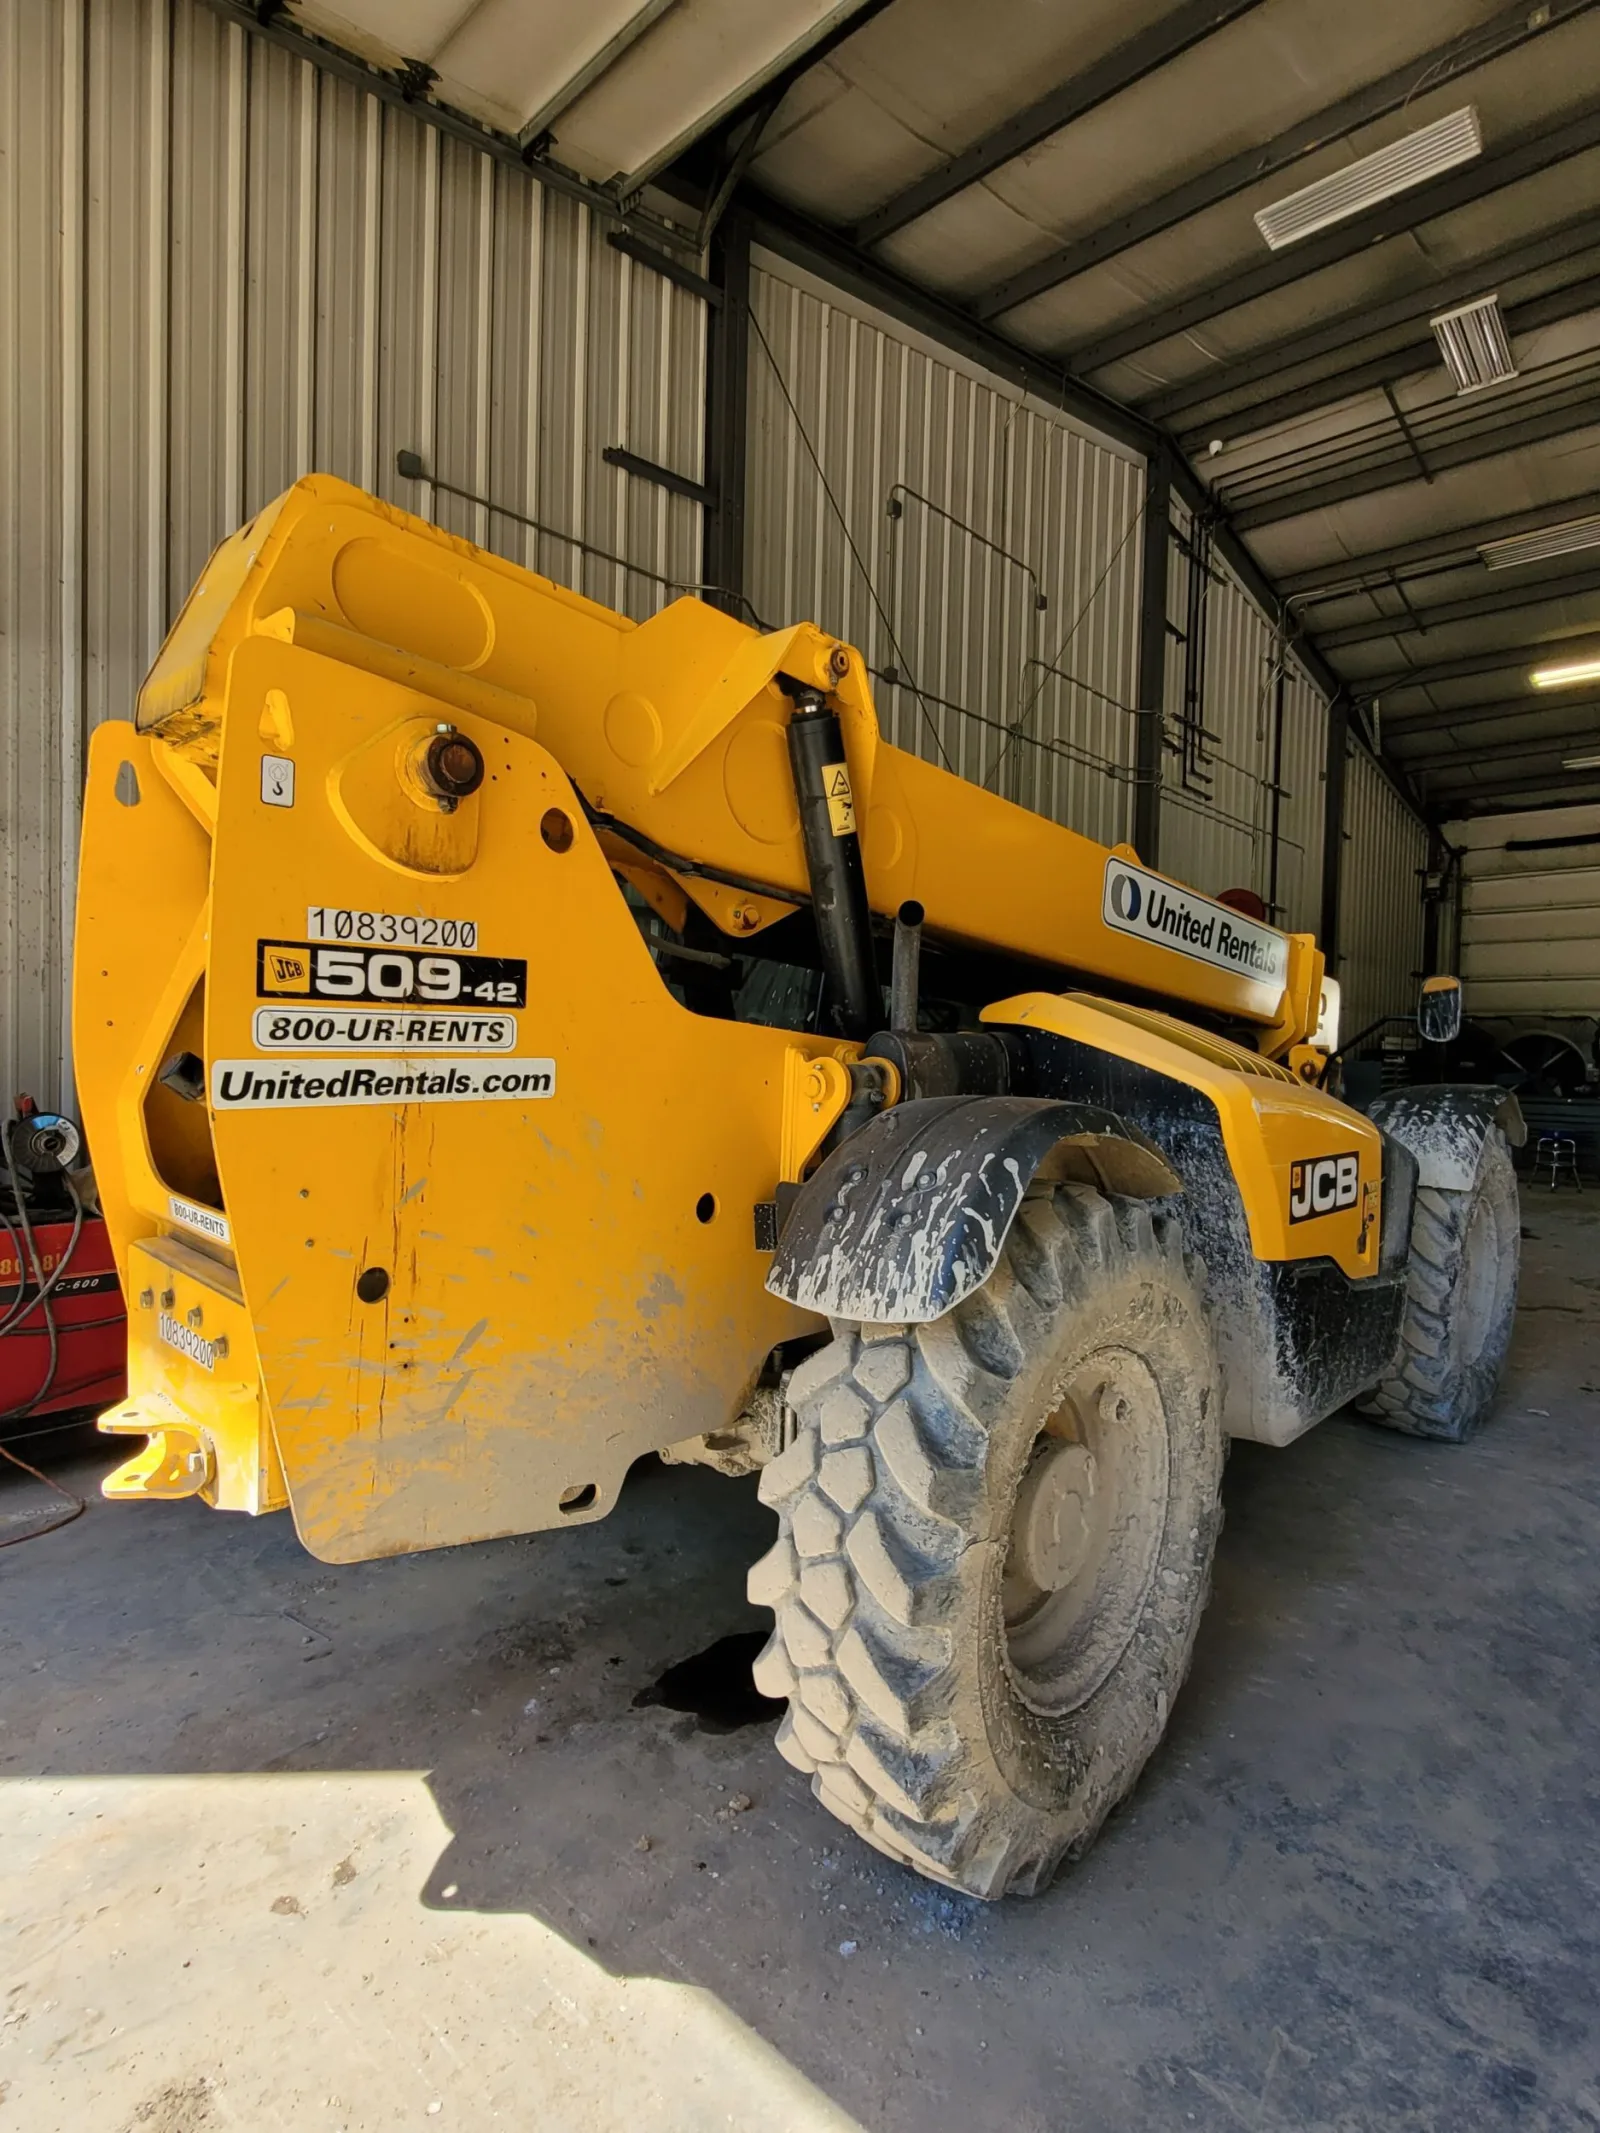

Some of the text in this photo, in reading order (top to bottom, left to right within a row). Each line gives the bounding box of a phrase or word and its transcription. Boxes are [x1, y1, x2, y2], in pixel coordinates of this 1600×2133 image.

[312, 908, 476, 949] 10839200
[1146, 889, 1276, 975] United Rentals
[275, 958, 303, 980] JCB
[269, 1017, 505, 1043] 800-UR-RENTS
[220, 1068, 551, 1101] UnitedRentals.com
[1291, 1156, 1358, 1218] JCB
[174, 1203, 225, 1237] 800-UR-RENTS
[161, 1312, 213, 1369] 10839200
